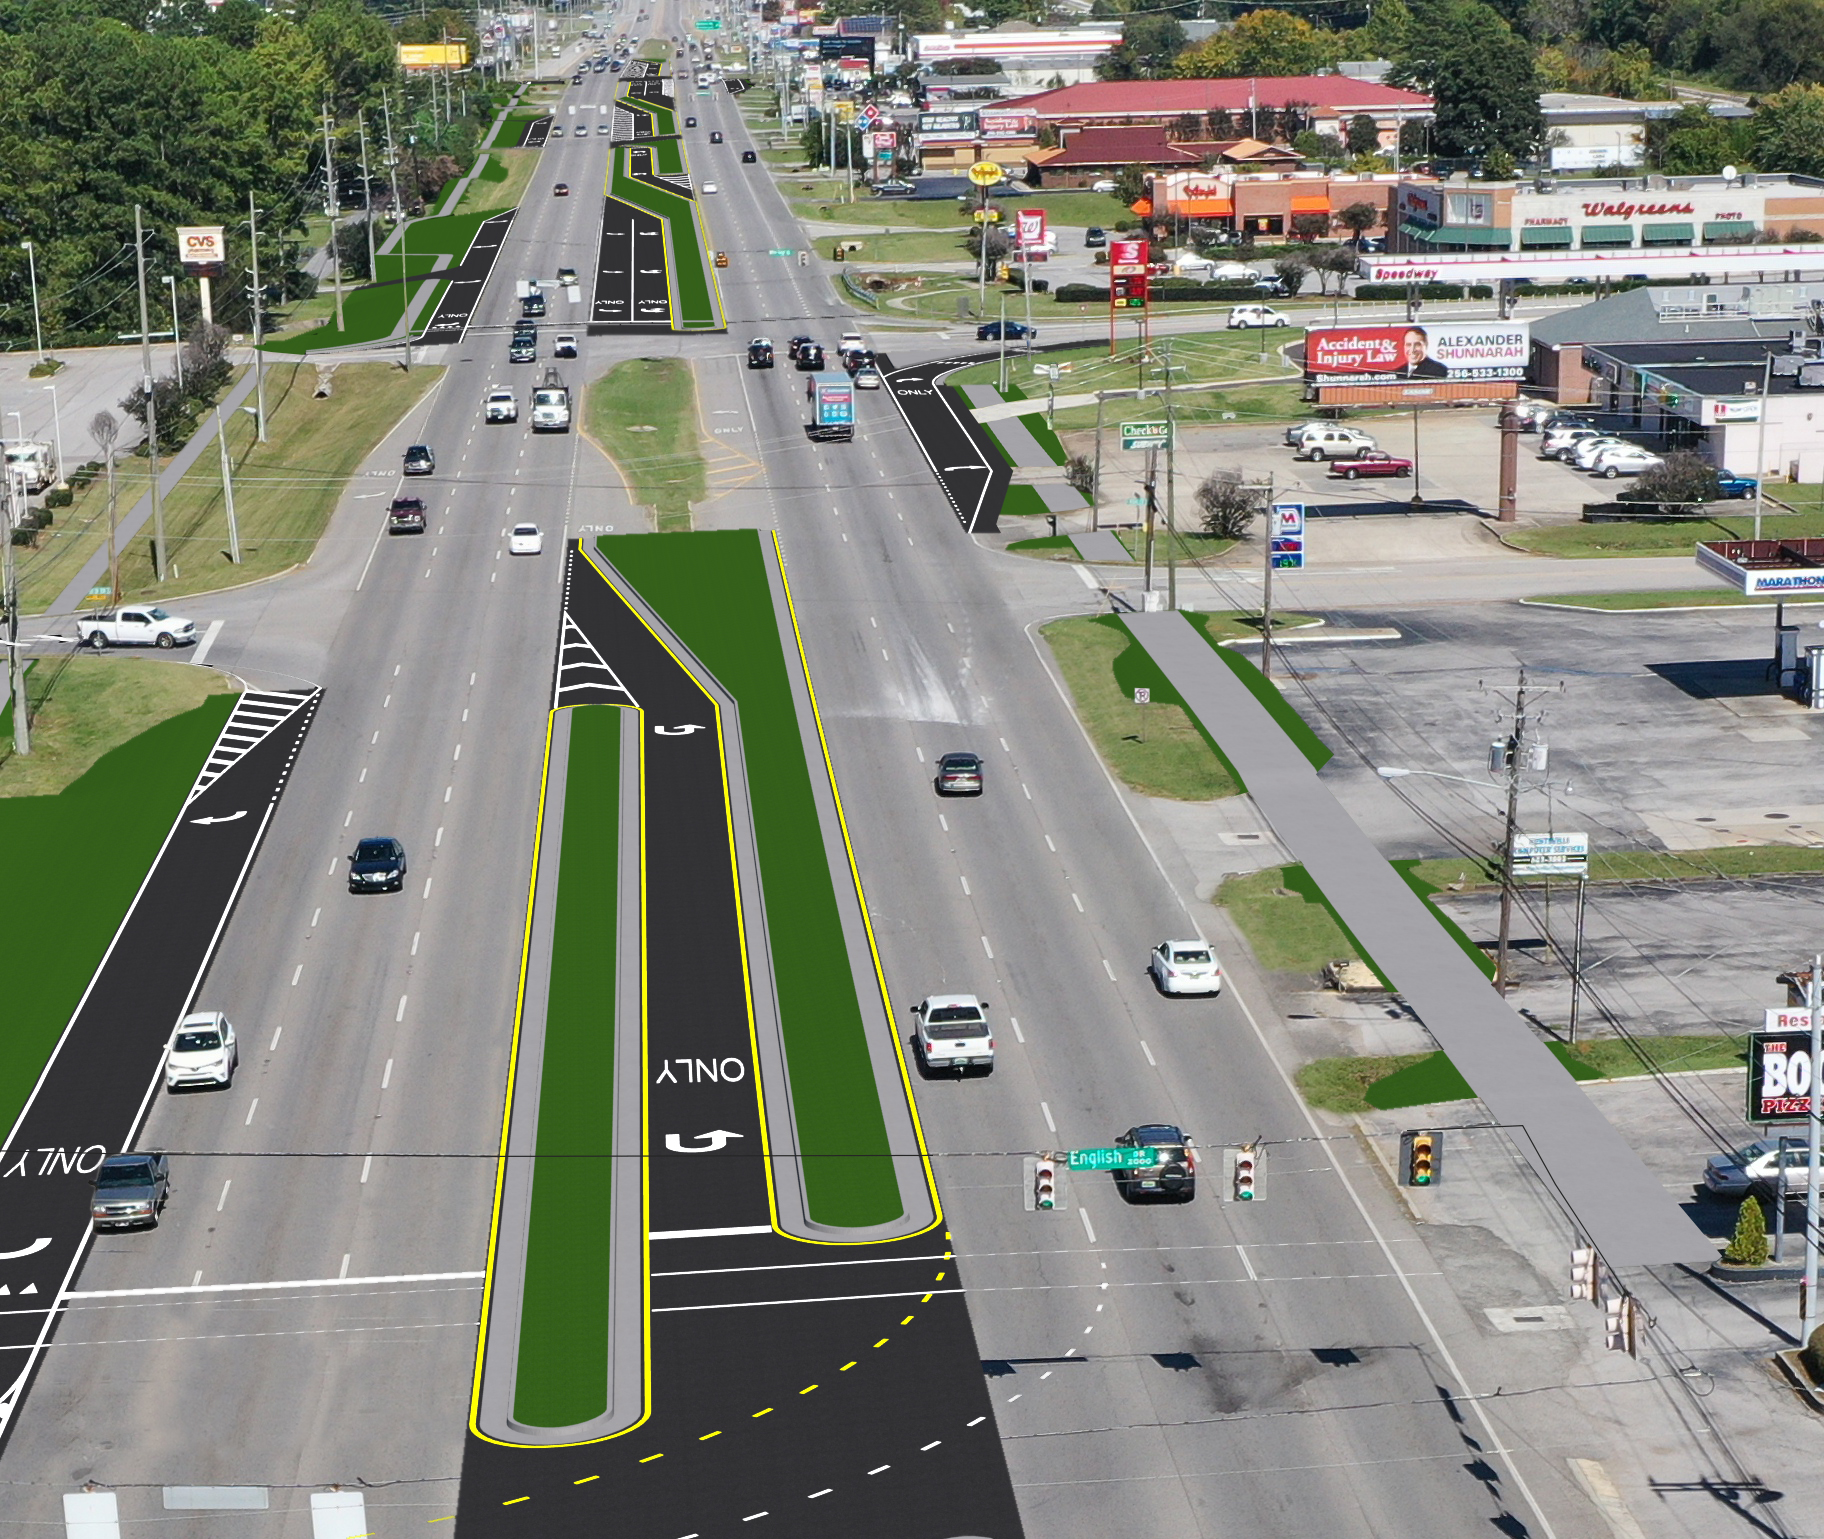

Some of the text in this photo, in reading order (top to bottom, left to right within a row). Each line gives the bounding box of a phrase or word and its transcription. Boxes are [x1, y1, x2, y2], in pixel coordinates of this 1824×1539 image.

[1582, 202, 1694, 220] Walgreens
[1524, 217, 1568, 226] PHARMACY
[187, 236, 215, 247] CVS
[1375, 268, 1439, 283] Speedway
[1317, 337, 1382, 351] Accident
[1438, 334, 1524, 347] ALEXANDER
[1317, 350, 1397, 366] Injury Law
[1437, 347, 1524, 360] SHUNNARAH
[1316, 373, 1397, 383] Shunnarah.com
[1446, 367, 1524, 379] 256-533-1300
[714, 426, 744, 434] ONLY
[1069, 1149, 1123, 1170] English
[1127, 1157, 1152, 1166] 2000
